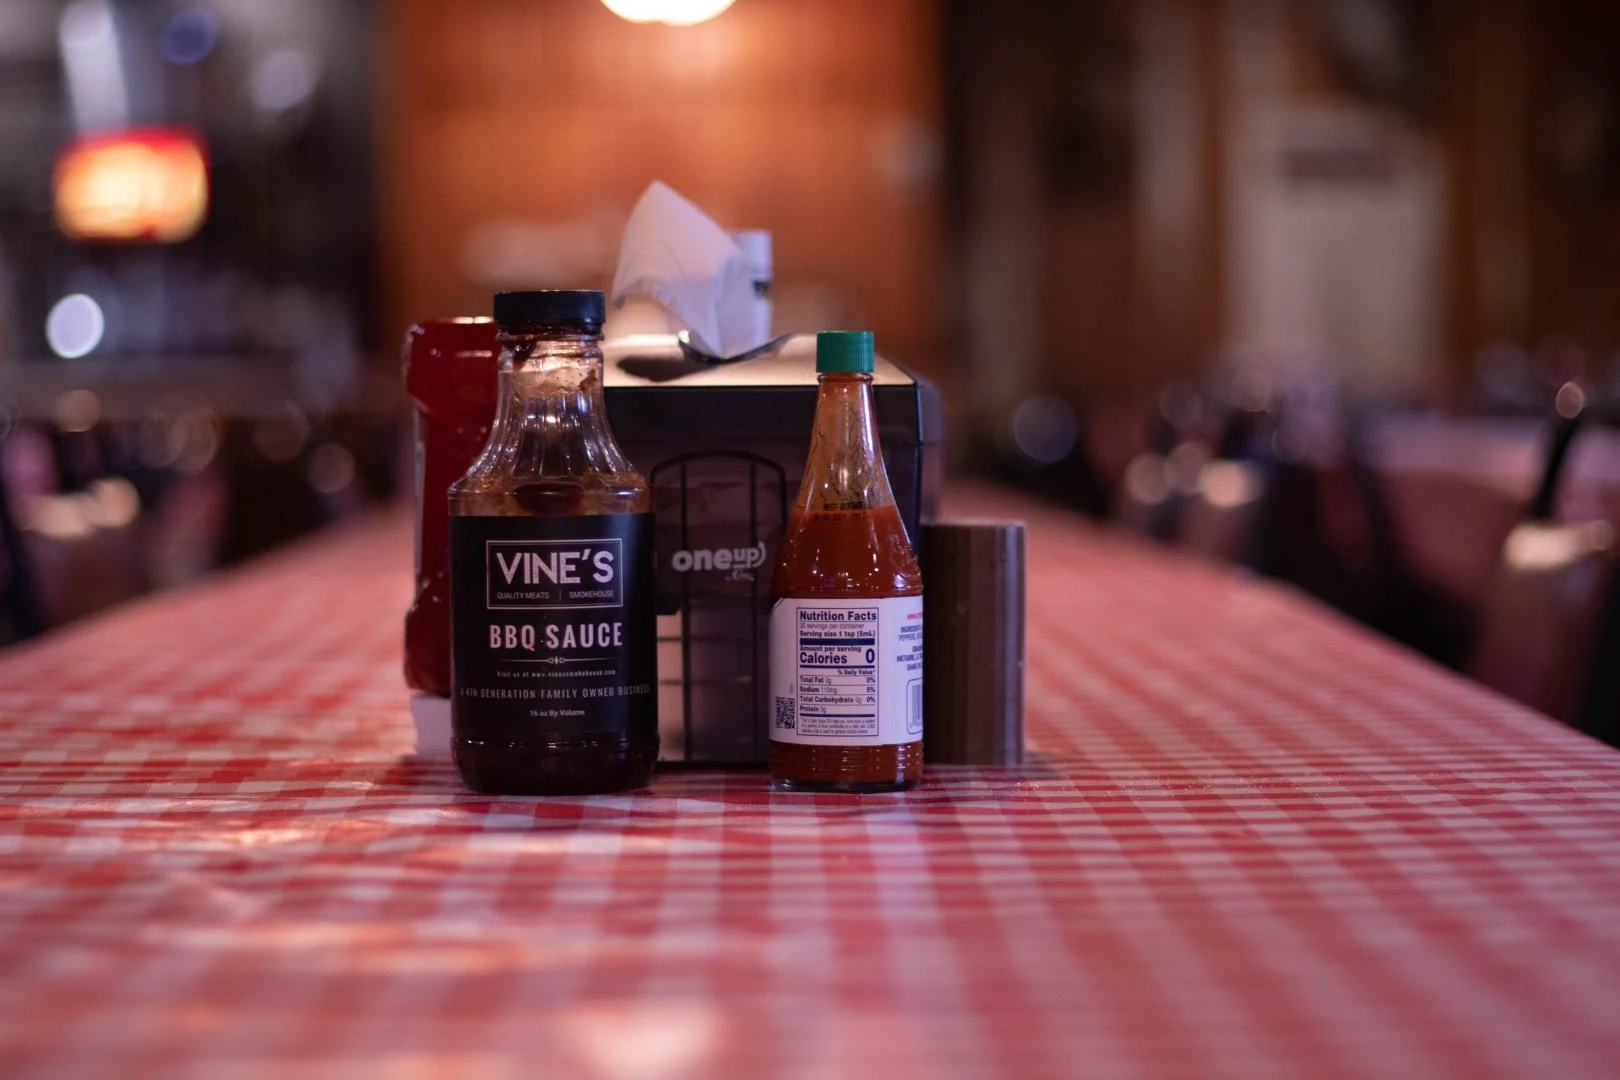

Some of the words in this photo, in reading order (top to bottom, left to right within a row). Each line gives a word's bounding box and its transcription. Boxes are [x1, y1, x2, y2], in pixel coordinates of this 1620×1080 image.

[496, 549, 614, 584] VINE'S
[525, 591, 550, 599] MEATS
[569, 590, 614, 599] SMOKEHOUSE
[800, 610, 844, 621] Nutrition
[847, 610, 877, 621] Facts
[807, 622, 828, 630] servings
[839, 622, 864, 630] container
[489, 624, 535, 651] BBQ
[546, 622, 623, 649] SAUCE
[799, 630, 822, 638] Serving
[856, 630, 876, 638] (5mL)
[799, 651, 847, 664] Calories
[865, 648, 875, 664] 0
[480, 688, 535, 699] GENERATION
[540, 688, 578, 699] FAMILY
[582, 687, 615, 698] OWNED
[814, 696, 854, 704] Carbohydrate
[549, 709, 558, 718] By
[559, 708, 585, 716] Volume
